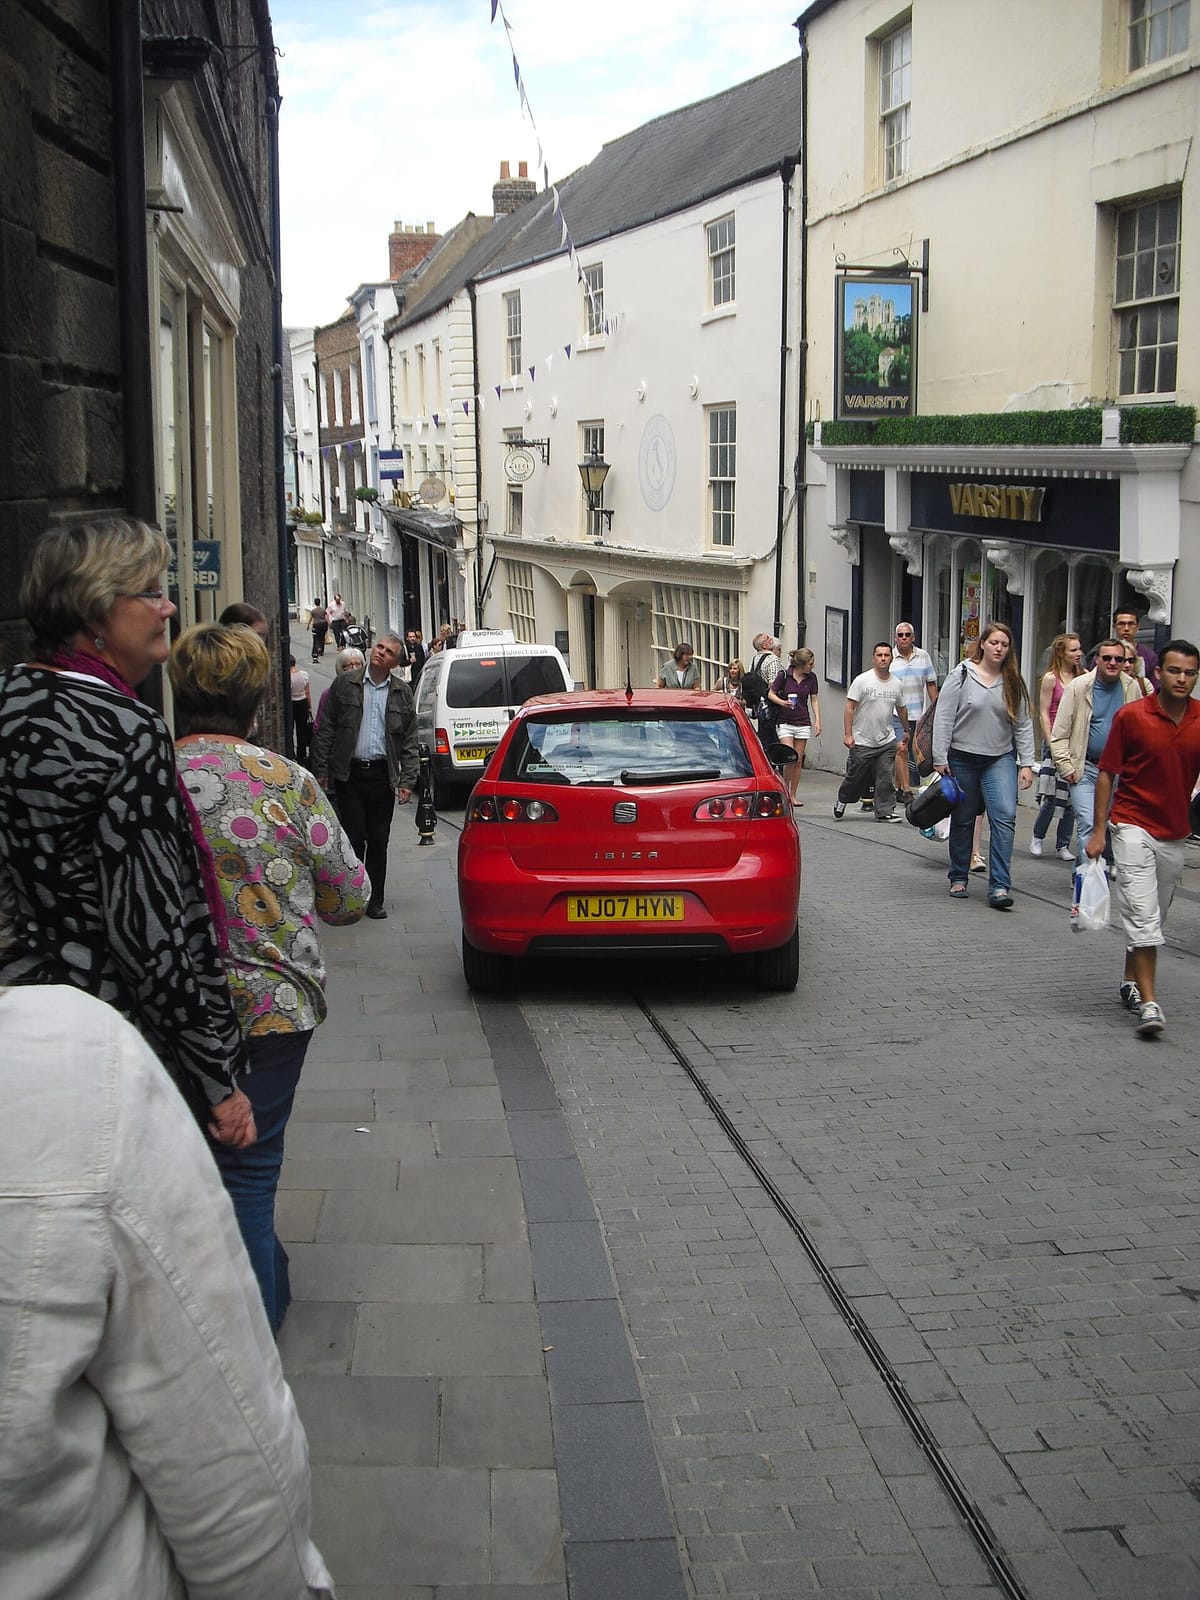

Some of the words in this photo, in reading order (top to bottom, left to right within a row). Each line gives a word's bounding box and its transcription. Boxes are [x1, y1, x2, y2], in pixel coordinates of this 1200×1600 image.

[844, 394, 909, 409] VARSITY
[949, 483, 1046, 522] VARSITY
[453, 721, 473, 729] farm
[476, 720, 499, 728] fresh
[594, 851, 658, 859] IBIZA
[577, 898, 630, 917] NJ07
[636, 898, 675, 917] HYN
